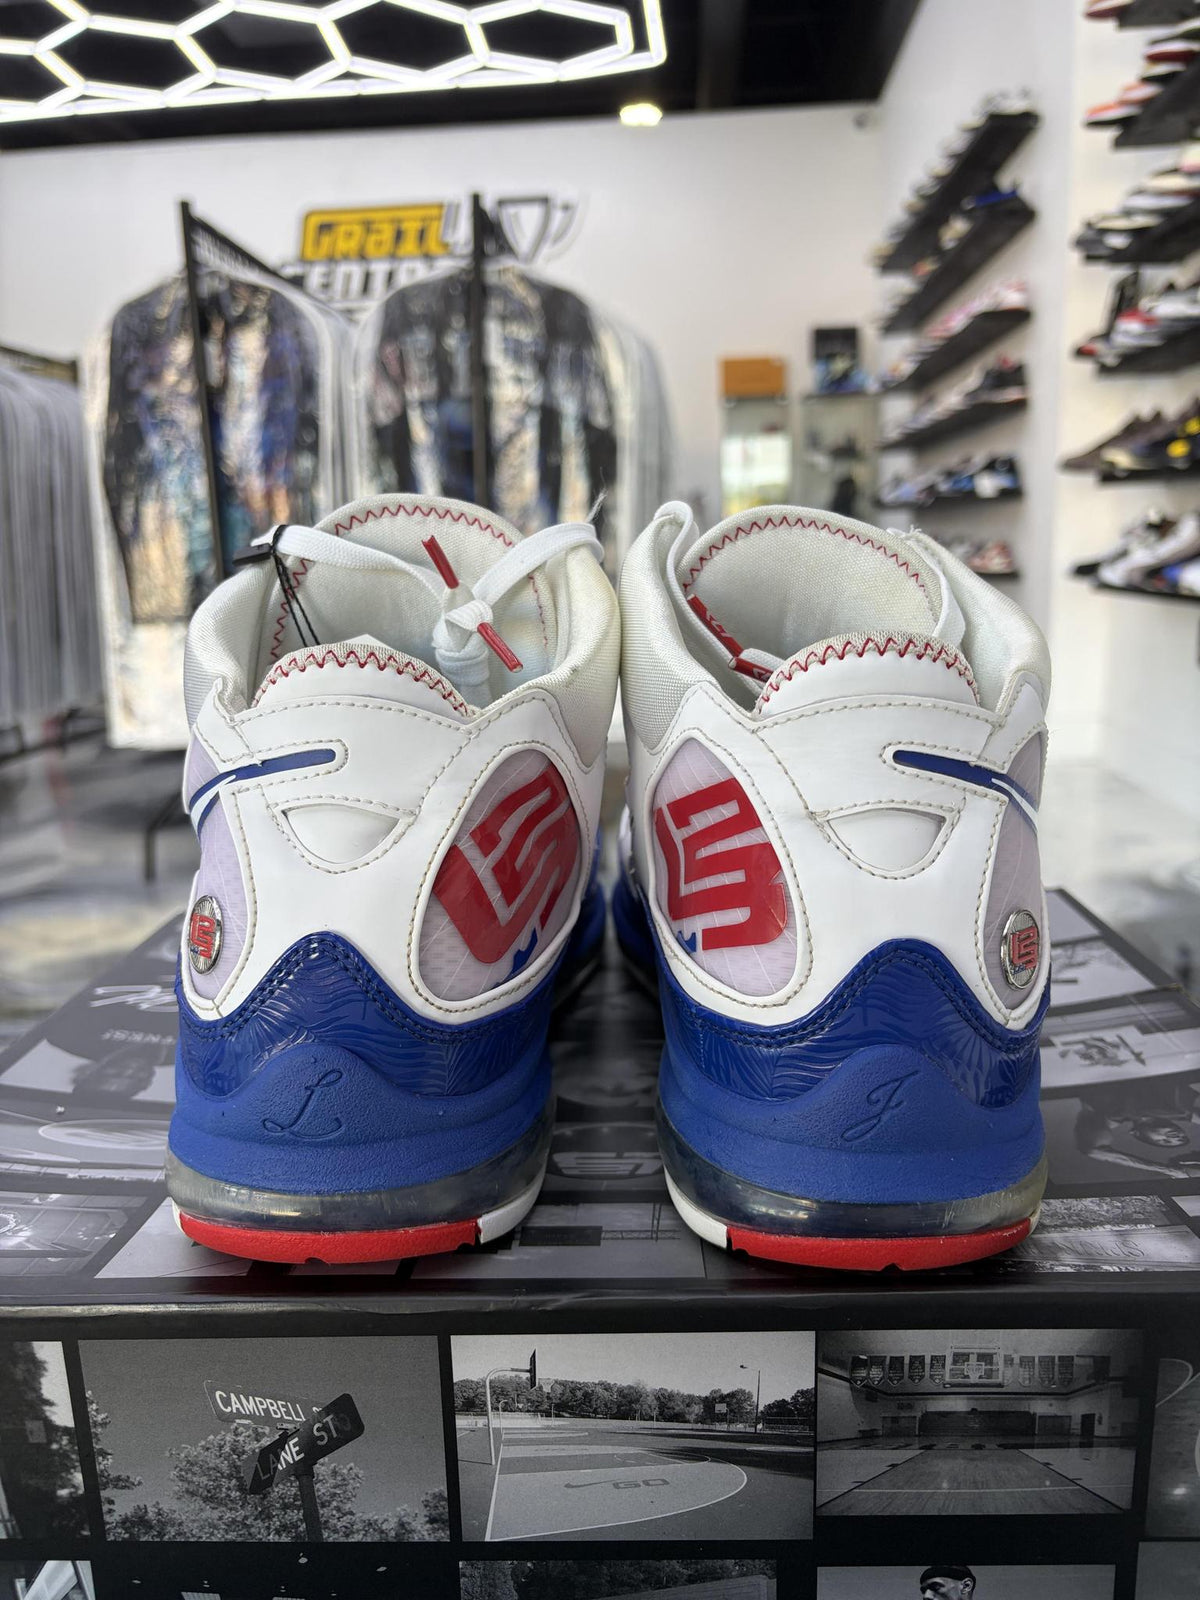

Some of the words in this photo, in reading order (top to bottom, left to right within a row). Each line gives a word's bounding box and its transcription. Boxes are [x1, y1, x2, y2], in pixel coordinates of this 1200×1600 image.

[215, 1390, 306, 1422] CAMPBELL
[256, 1436, 305, 1480] LANE
[312, 1414, 338, 1446] ST
